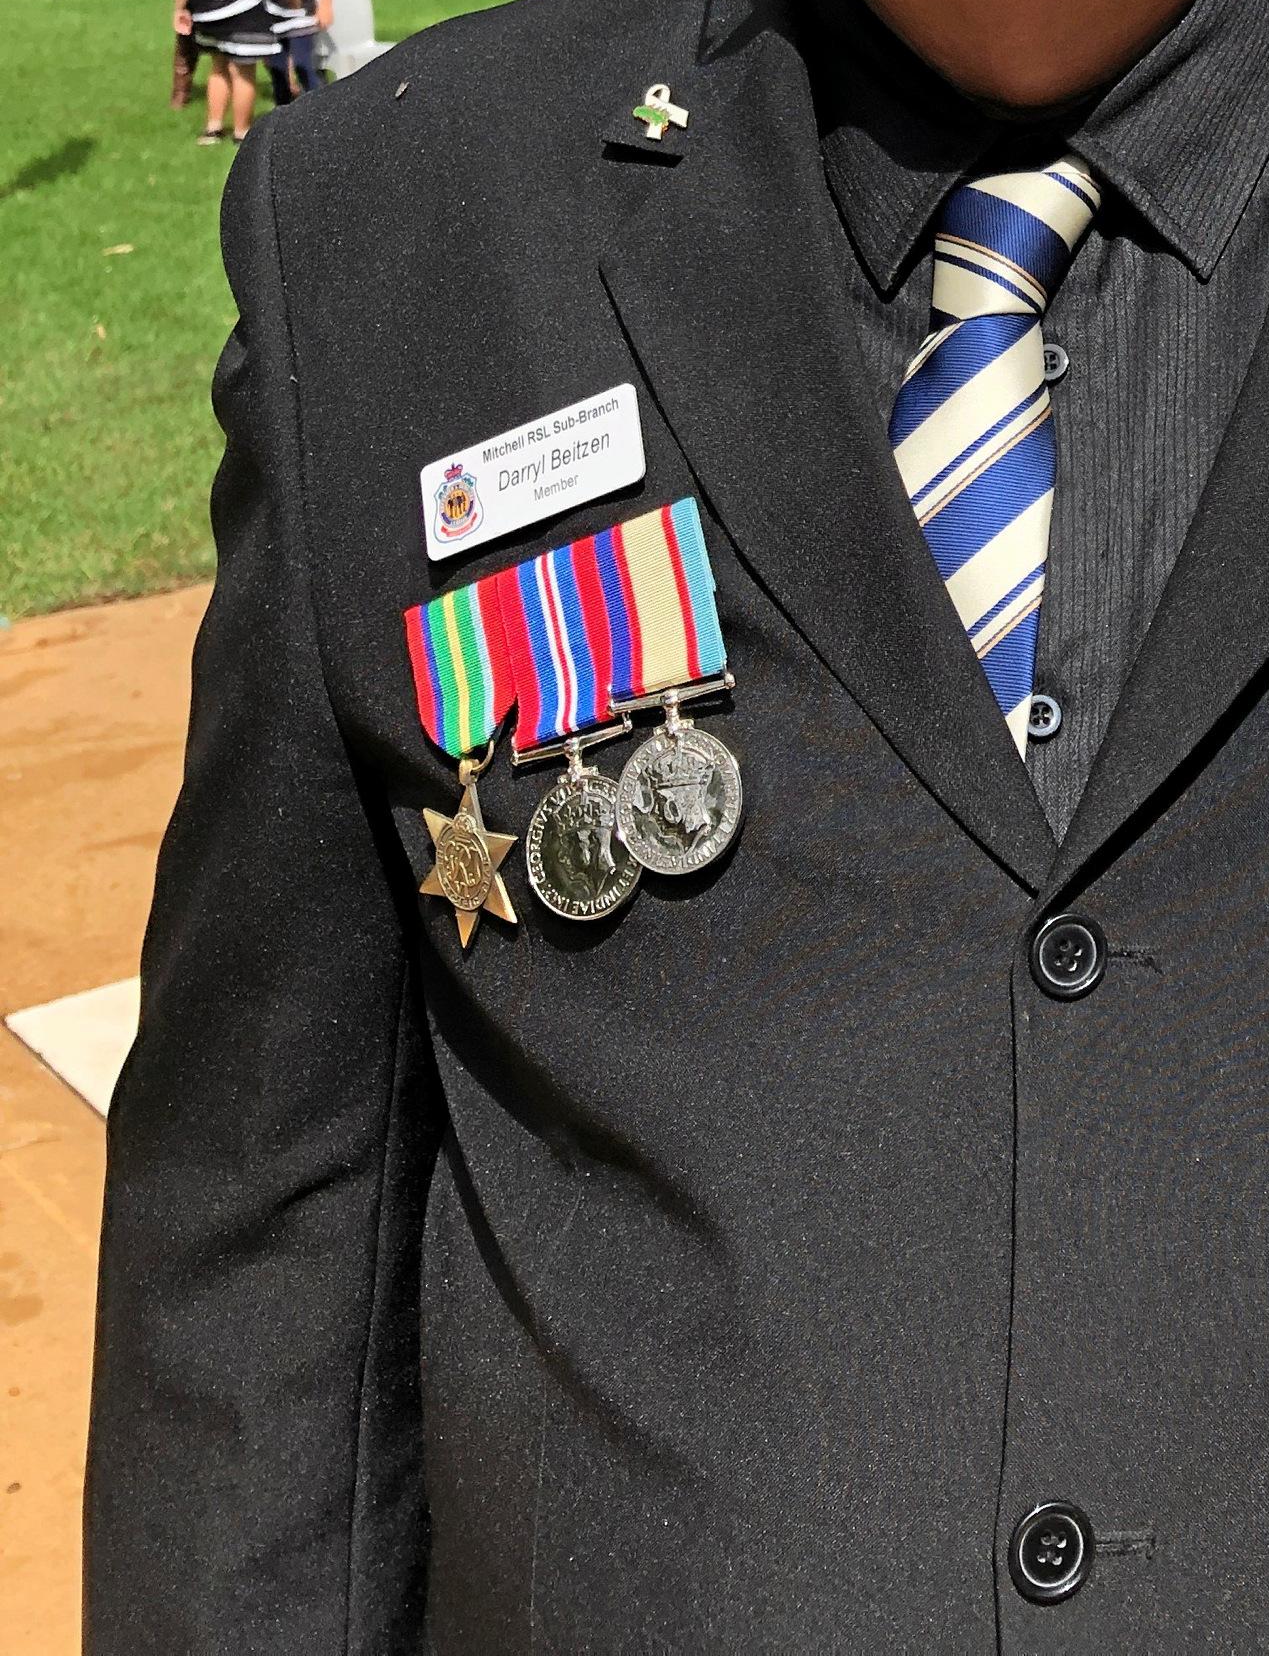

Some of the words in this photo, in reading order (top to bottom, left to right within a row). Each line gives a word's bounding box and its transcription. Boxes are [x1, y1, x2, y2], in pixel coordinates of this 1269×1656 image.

[482, 435, 525, 465] Mitchell
[527, 425, 551, 445] RSL
[553, 397, 619, 436] Sub-Branch
[498, 453, 546, 492] Darryl
[551, 432, 610, 471] Beitzen
[533, 474, 580, 502] Member
